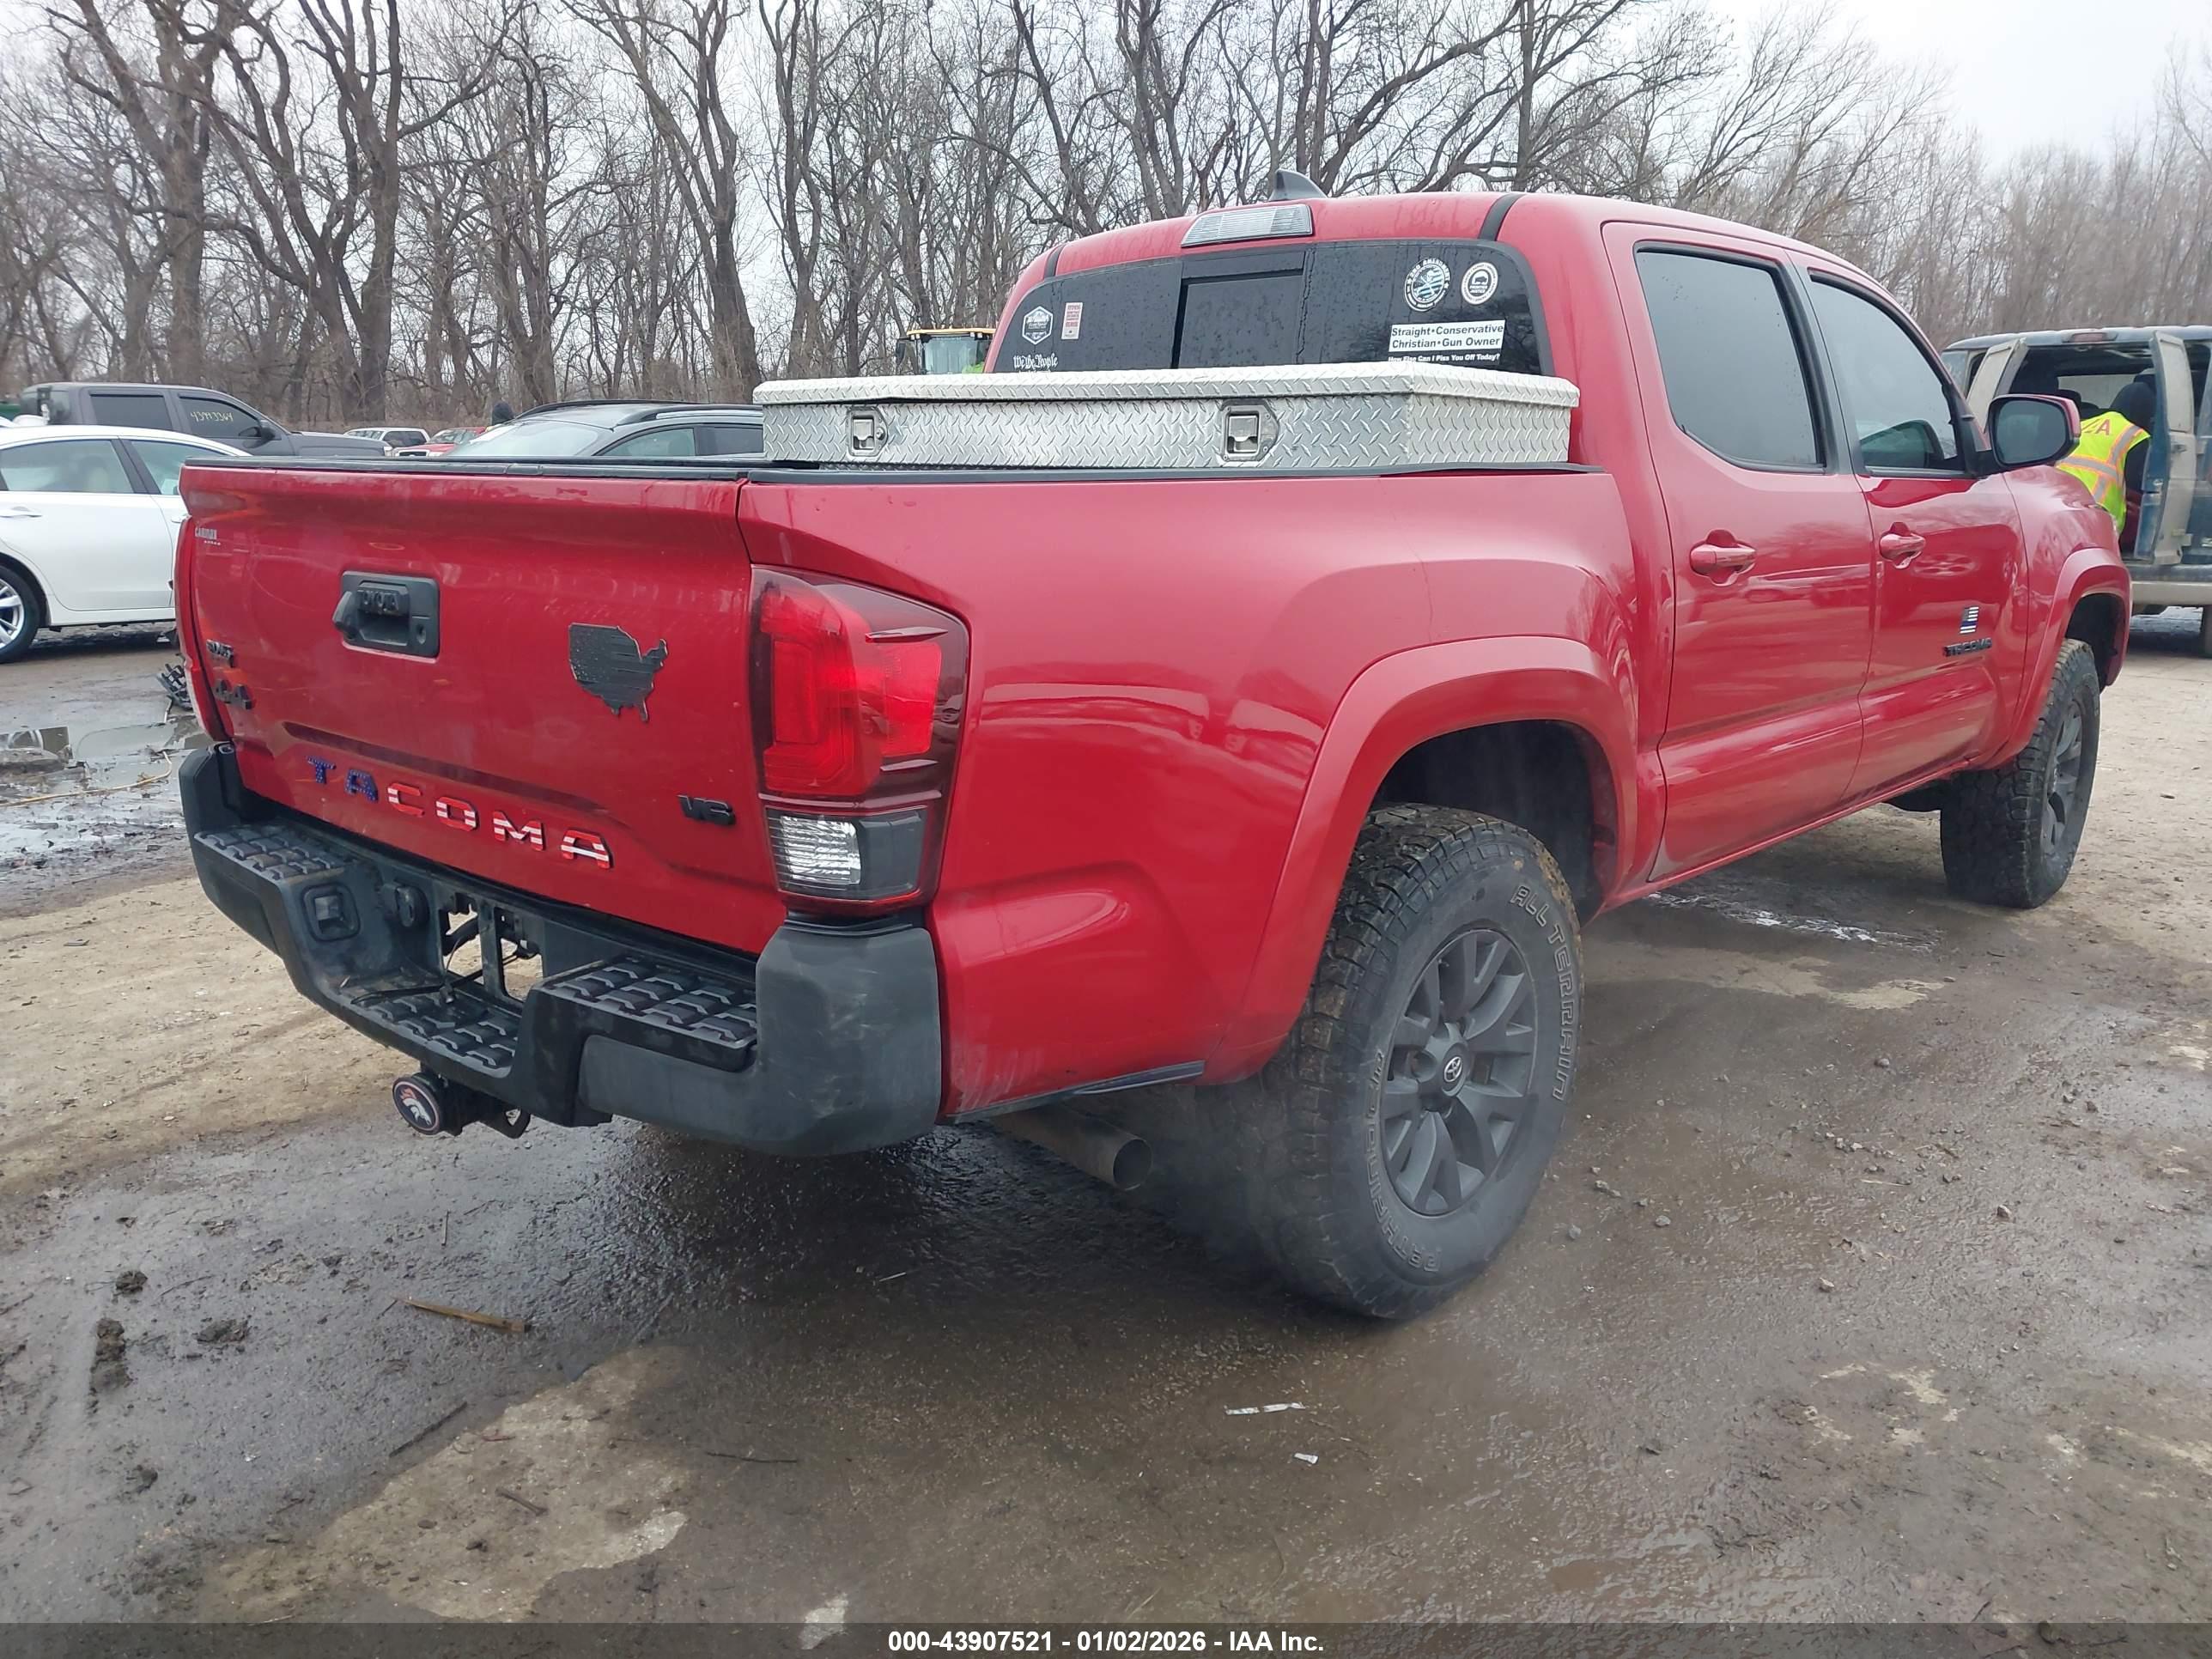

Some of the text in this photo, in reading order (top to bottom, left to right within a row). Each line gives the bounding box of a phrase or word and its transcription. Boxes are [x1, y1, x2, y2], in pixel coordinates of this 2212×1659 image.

[1466, 337, 1500, 346] Owner
[1476, 353, 1500, 362] Today?
[307, 756, 613, 869] TACOMA
[677, 794, 736, 825] V6
[1510, 885, 1575, 1101] ALL TERRAIN
